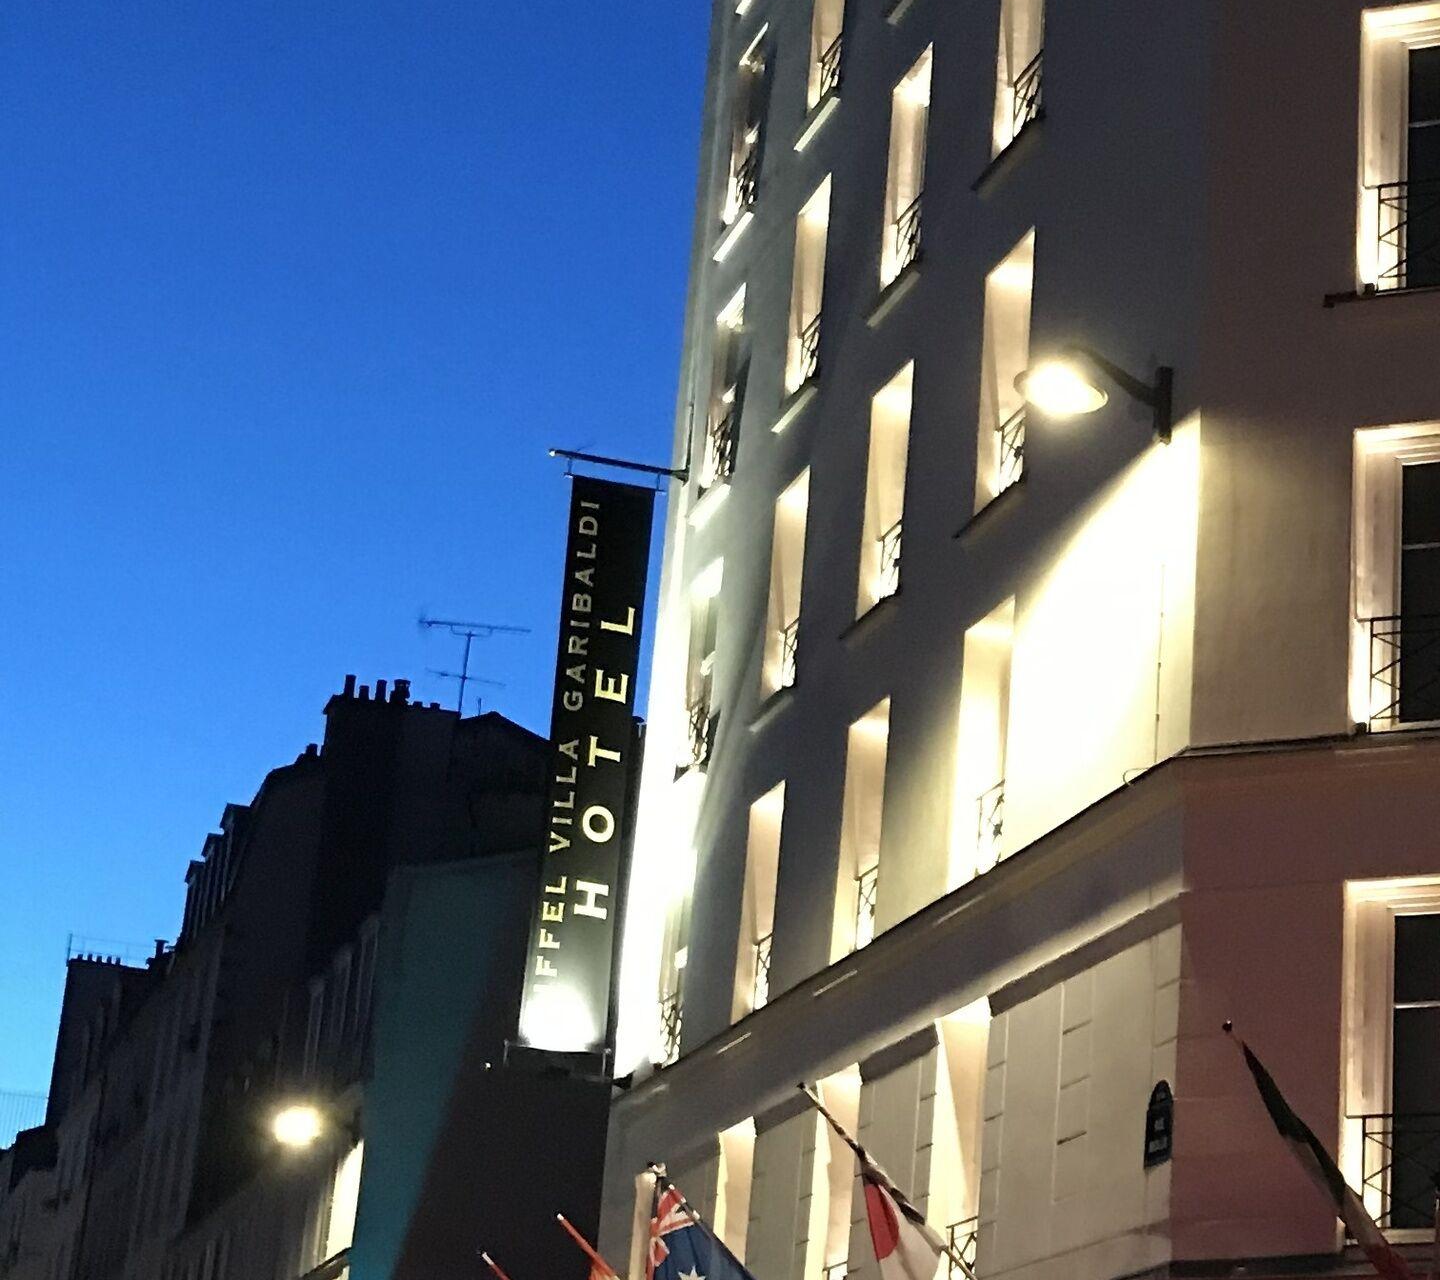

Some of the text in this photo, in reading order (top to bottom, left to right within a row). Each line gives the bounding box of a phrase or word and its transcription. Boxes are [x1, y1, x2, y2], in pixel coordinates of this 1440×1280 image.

[533, 499, 600, 994] IFFEL VILLA GARIBALDI
[573, 606, 636, 921] HOTEL
